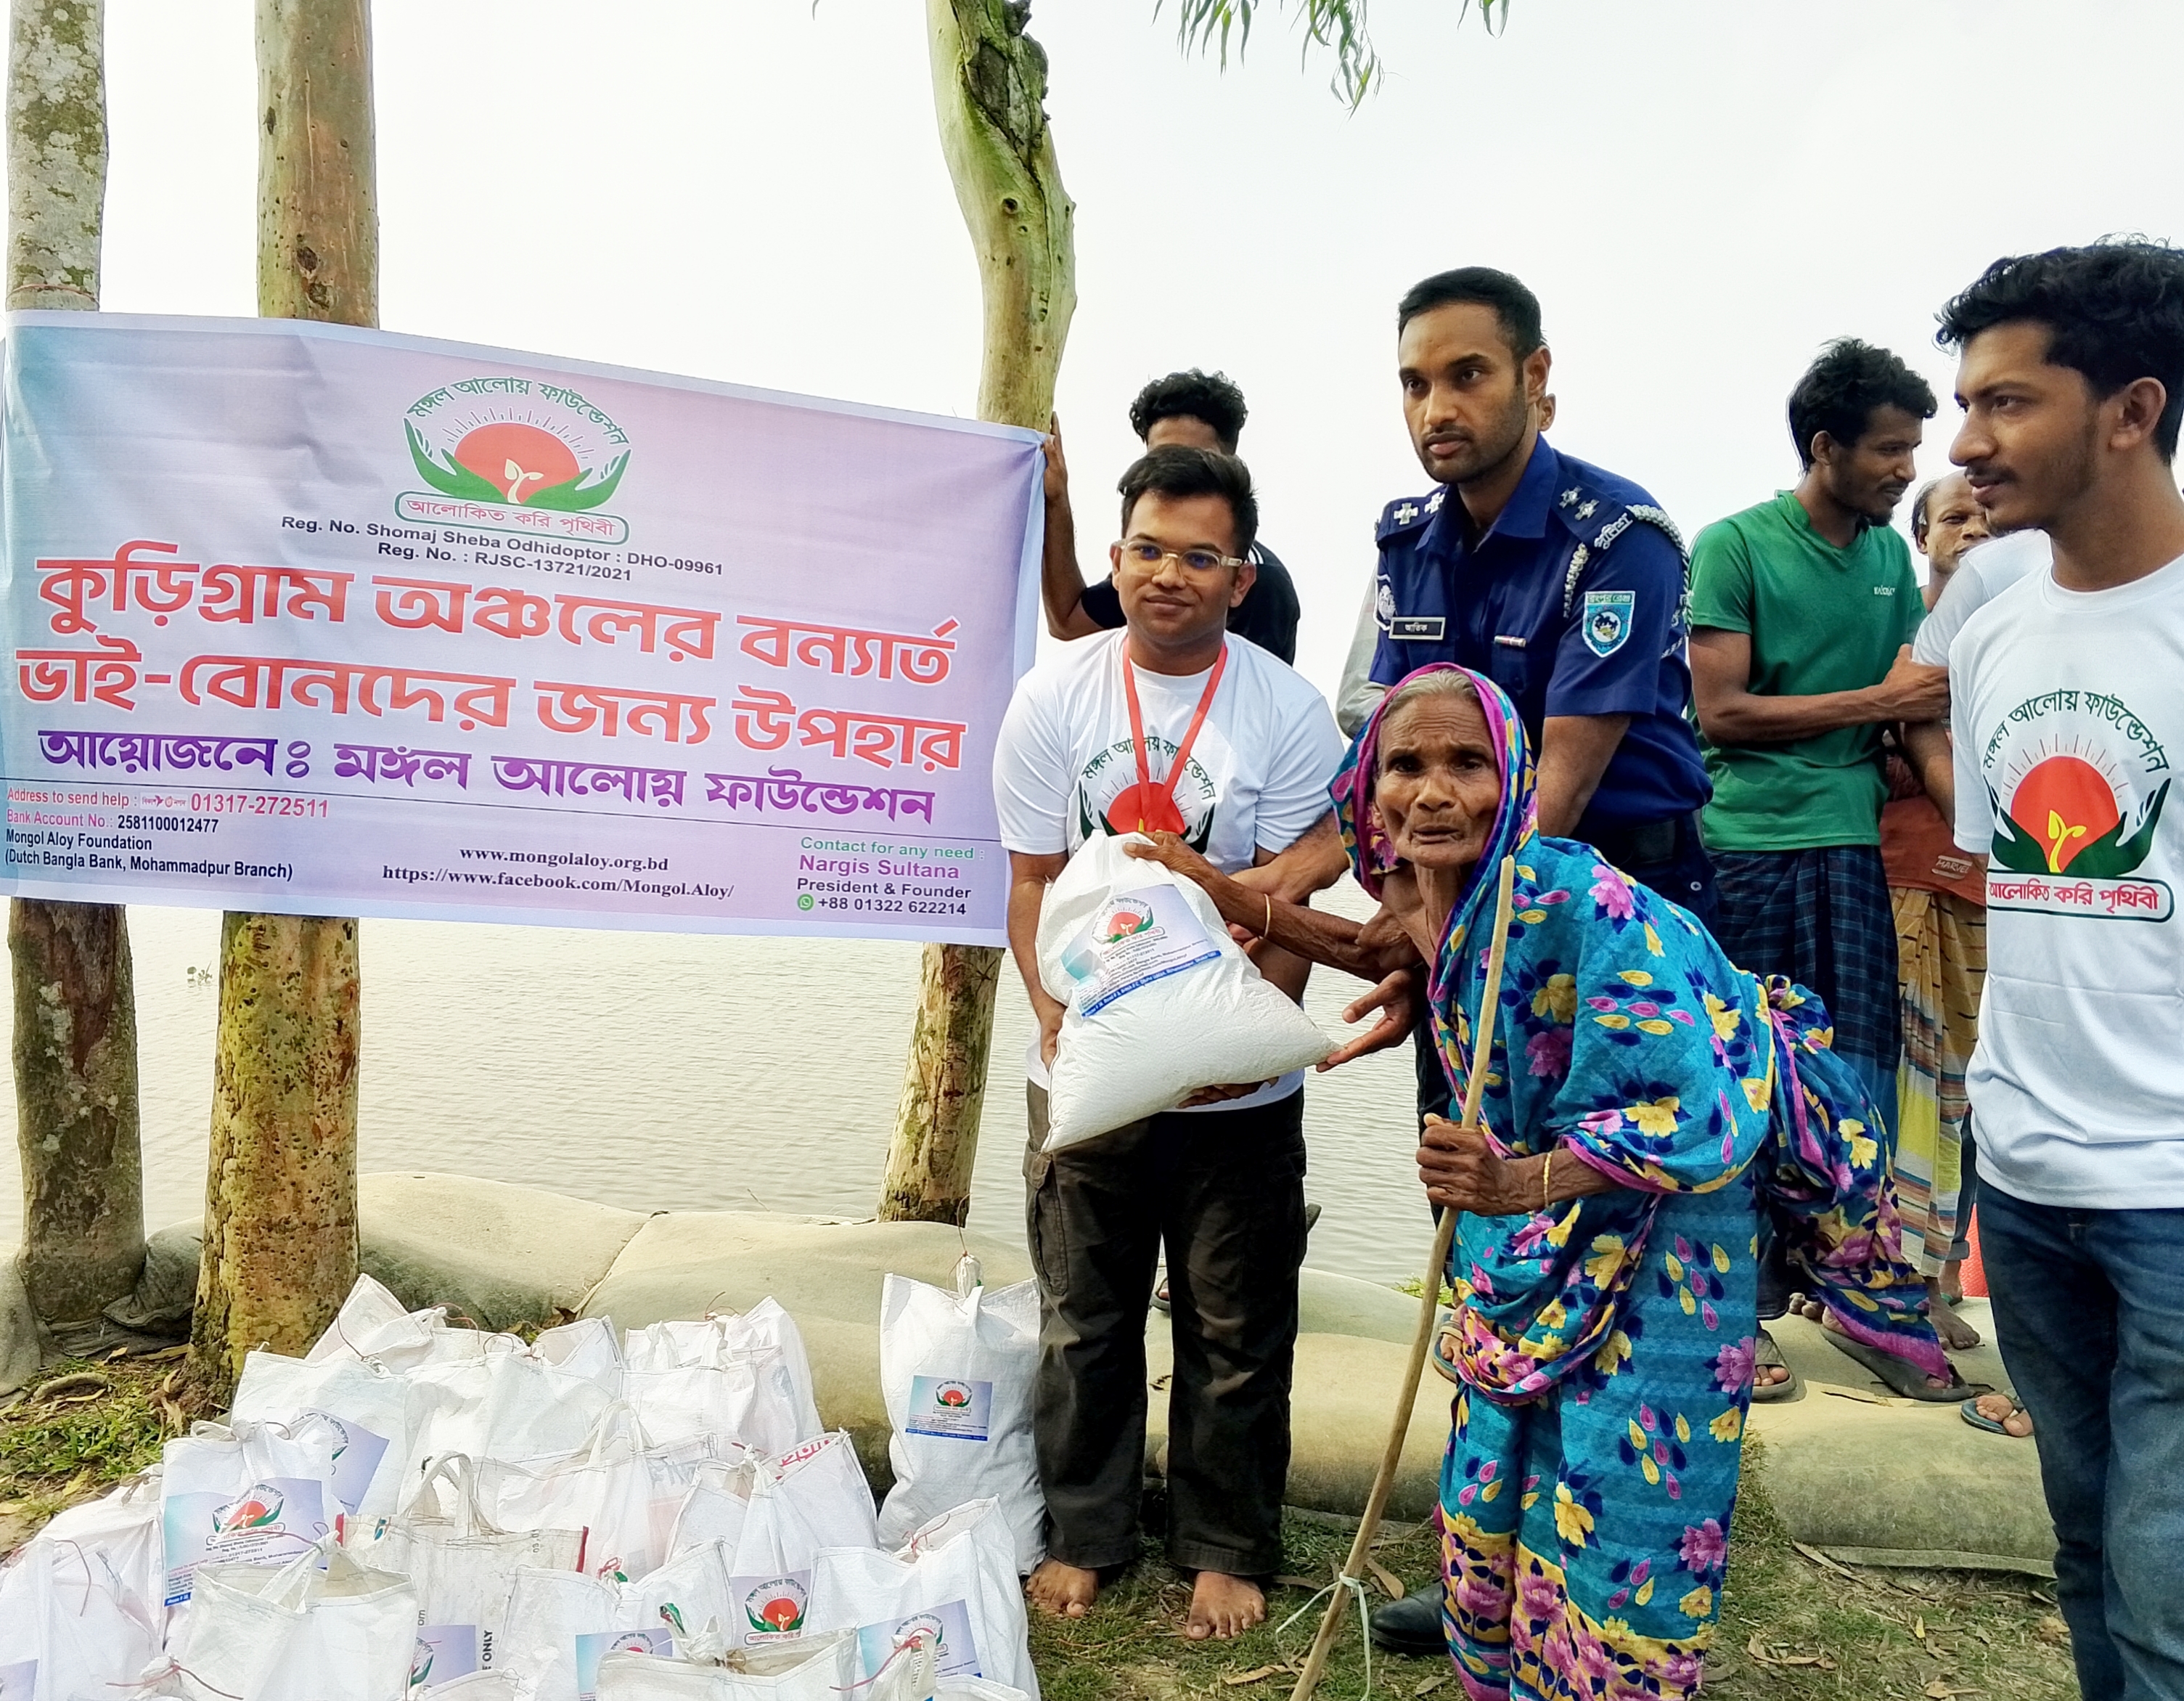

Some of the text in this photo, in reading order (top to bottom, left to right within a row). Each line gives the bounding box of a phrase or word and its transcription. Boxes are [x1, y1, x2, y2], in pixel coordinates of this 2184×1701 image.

[406, 376, 630, 445] মঙ্গল আলোয় ফাউন্ডেশন
[406, 499, 616, 537] আলোকিত করি পৃথিবী
[282, 515, 324, 533] Reg.
[330, 520, 361, 535] No.
[366, 523, 438, 544] Shomaj
[443, 530, 501, 550] Sheba
[507, 537, 611, 562] Odhidoptor
[627, 552, 724, 576] DHO-09961
[377, 542, 420, 560] Reg.
[425, 547, 457, 562] No.
[475, 551, 632, 582] RJSC-13721/2021
[35, 539, 962, 684] কুড়িগ্রাম অঞ্চলের বন্যার্ত
[15, 635, 966, 772] ভাই-বোনদের জন্য উপহার
[1983, 688, 2170, 773] মঙ্গল আলোয় ফাউন্ডেশন
[1081, 748, 1113, 780] মঙ্গল
[7, 787, 49, 803] Address
[52, 792, 65, 804] to
[68, 790, 98, 805] send
[102, 792, 130, 809] help
[333, 742, 472, 790] মঙ্গল
[491, 754, 687, 807] আলোয়
[705, 764, 935, 824] ফাউন্ডেশন
[191, 792, 329, 818] 01317-272511
[7, 809, 32, 824] Bank
[34, 811, 84, 827] Account
[118, 815, 219, 834] 2581100012477
[6, 831, 152, 851] Mongol Aloy Foundation
[801, 836, 867, 853] Contact
[871, 841, 894, 854] for
[899, 846, 928, 860] any
[934, 847, 974, 859] need
[5, 848, 293, 881] (Dutch Bangla Bank, Mohammadpur Branch)
[459, 847, 669, 871] www.mongolaloy.org.bd
[799, 854, 960, 879] Nargis Sultana
[1936, 858, 1972, 874] MARVEL
[382, 865, 735, 900] https://www.facebook.com/Mongol.Aloy/
[797, 878, 972, 899] President & Founder
[2053, 881, 2093, 905] করি
[2099, 884, 2159, 914] পৃথিবী
[818, 897, 967, 915] +88 01322 622214
[482, 1630, 493, 1662] ONLY
